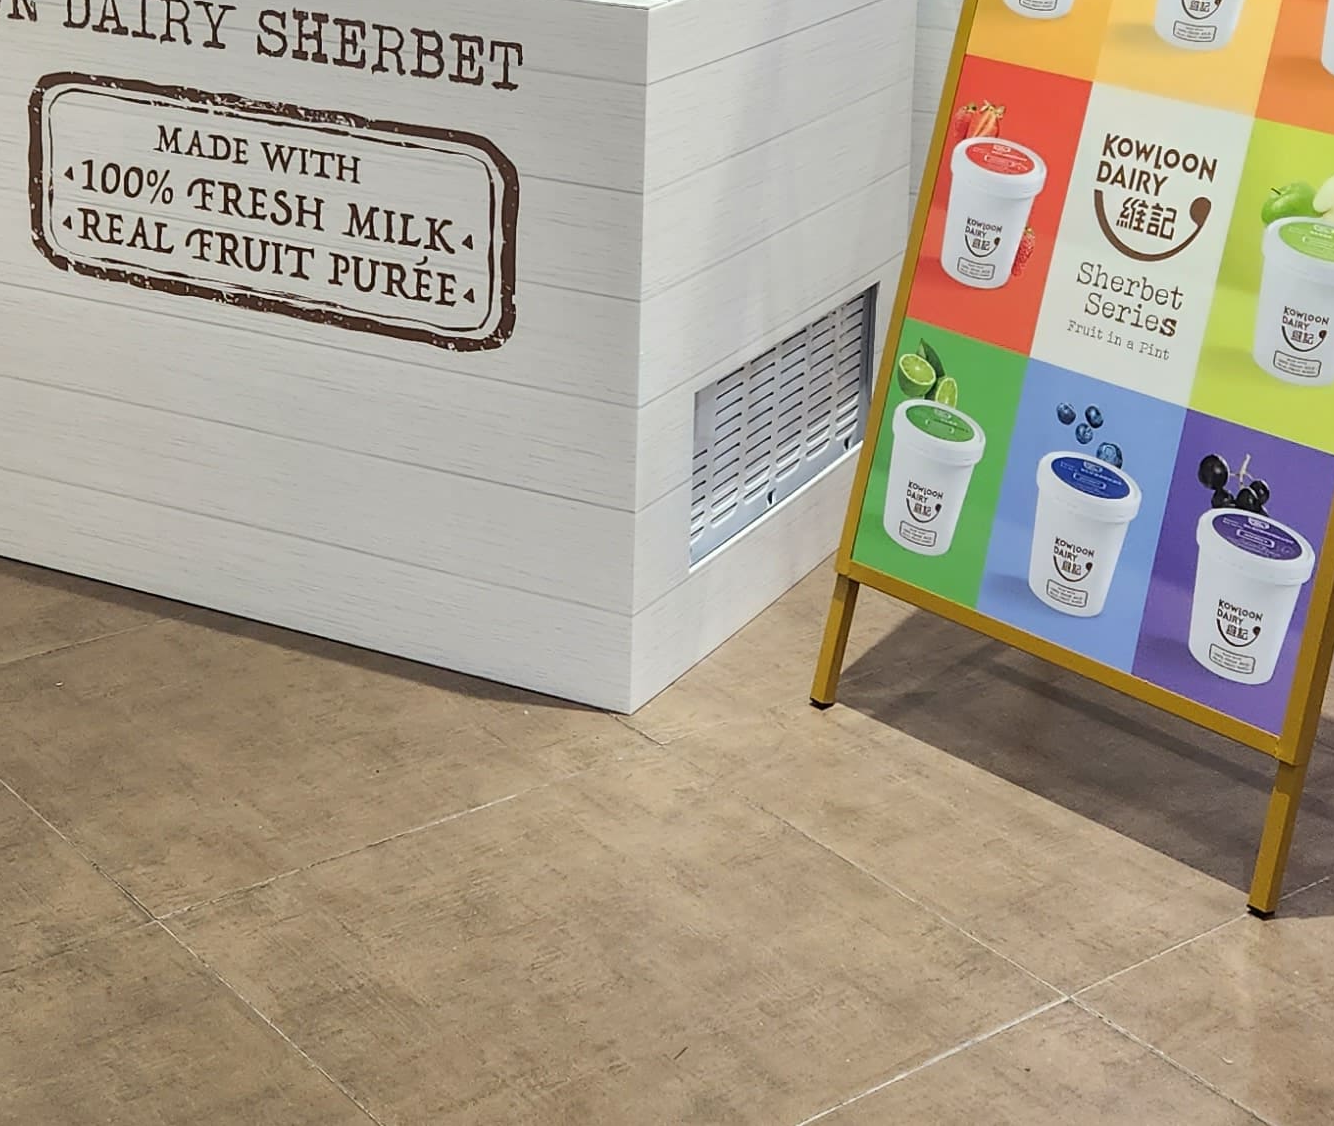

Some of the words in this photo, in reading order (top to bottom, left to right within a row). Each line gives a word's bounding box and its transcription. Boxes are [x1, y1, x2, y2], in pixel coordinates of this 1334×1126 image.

[255, 10, 525, 91] SHERBET
[154, 124, 249, 165] MADE
[260, 141, 361, 184] WITH
[1096, 160, 1168, 196] DAIRY
[1102, 133, 1218, 183] KOWLOON
[80, 160, 174, 205] 100%
[187, 177, 325, 232] FRESH
[342, 203, 457, 255] MILK
[1116, 197, 1177, 241] 維記
[77, 208, 175, 255] REAL
[185, 228, 314, 281] FRUIT
[328, 253, 458, 307] PURÉE
[1076, 262, 1184, 310] Sherbet
[1084, 292, 1178, 337] Series
[1067, 320, 1103, 340] Fruit
[1107, 332, 1122, 347] in
[1126, 339, 1134, 350] a
[1139, 341, 1170, 361] Pint
